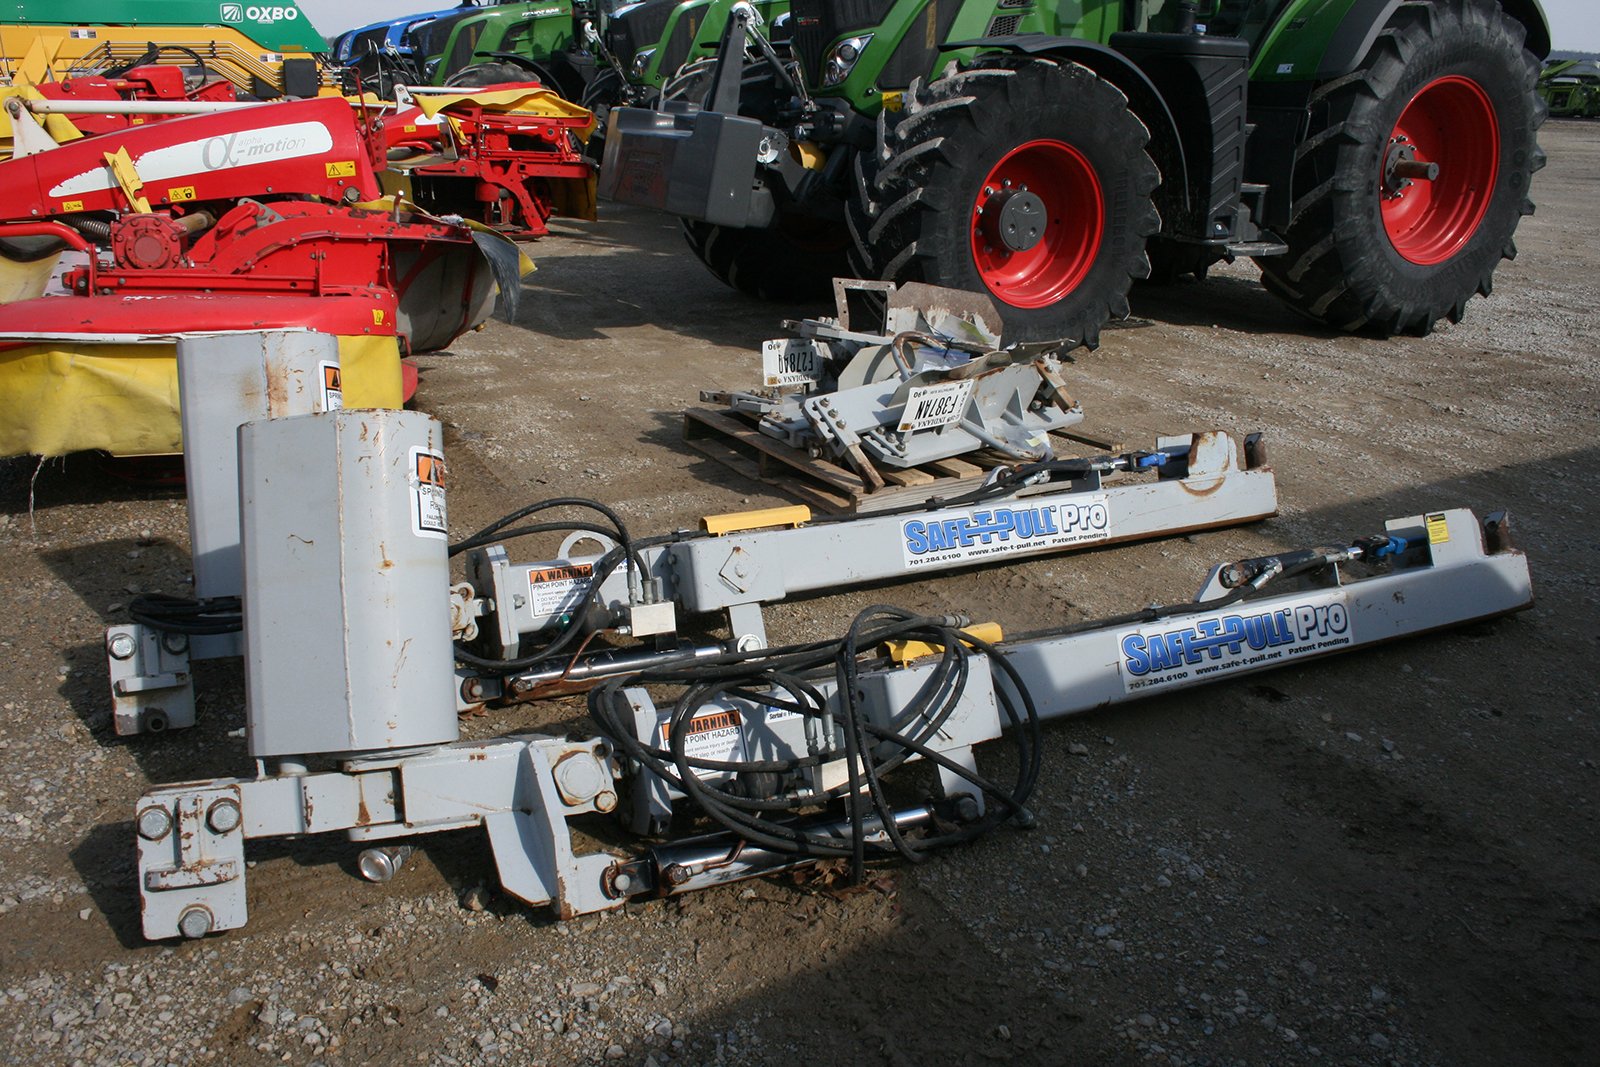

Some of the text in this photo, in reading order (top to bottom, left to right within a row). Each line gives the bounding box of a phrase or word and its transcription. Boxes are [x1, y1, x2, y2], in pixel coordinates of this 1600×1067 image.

[246, 6, 298, 21] OXBO
[783, 375, 811, 383] INDIANA
[914, 394, 959, 420] F387AN
[917, 417, 946, 428] INDIANA
[1060, 503, 1108, 532] Pro
[909, 532, 1108, 566] 701.284.6100 www.safe-t-pull.net Patent Pending
[547, 567, 589, 580] WARNING
[533, 581, 551, 591] PINCH
[551, 580, 568, 588] POINT
[1295, 602, 1348, 641] Pro
[1129, 636, 1350, 690] 701.284.6100 www.safe-t-pull.net Patent Pending
[689, 732, 710, 744] POINT
[712, 727, 740, 738] HAZARD
